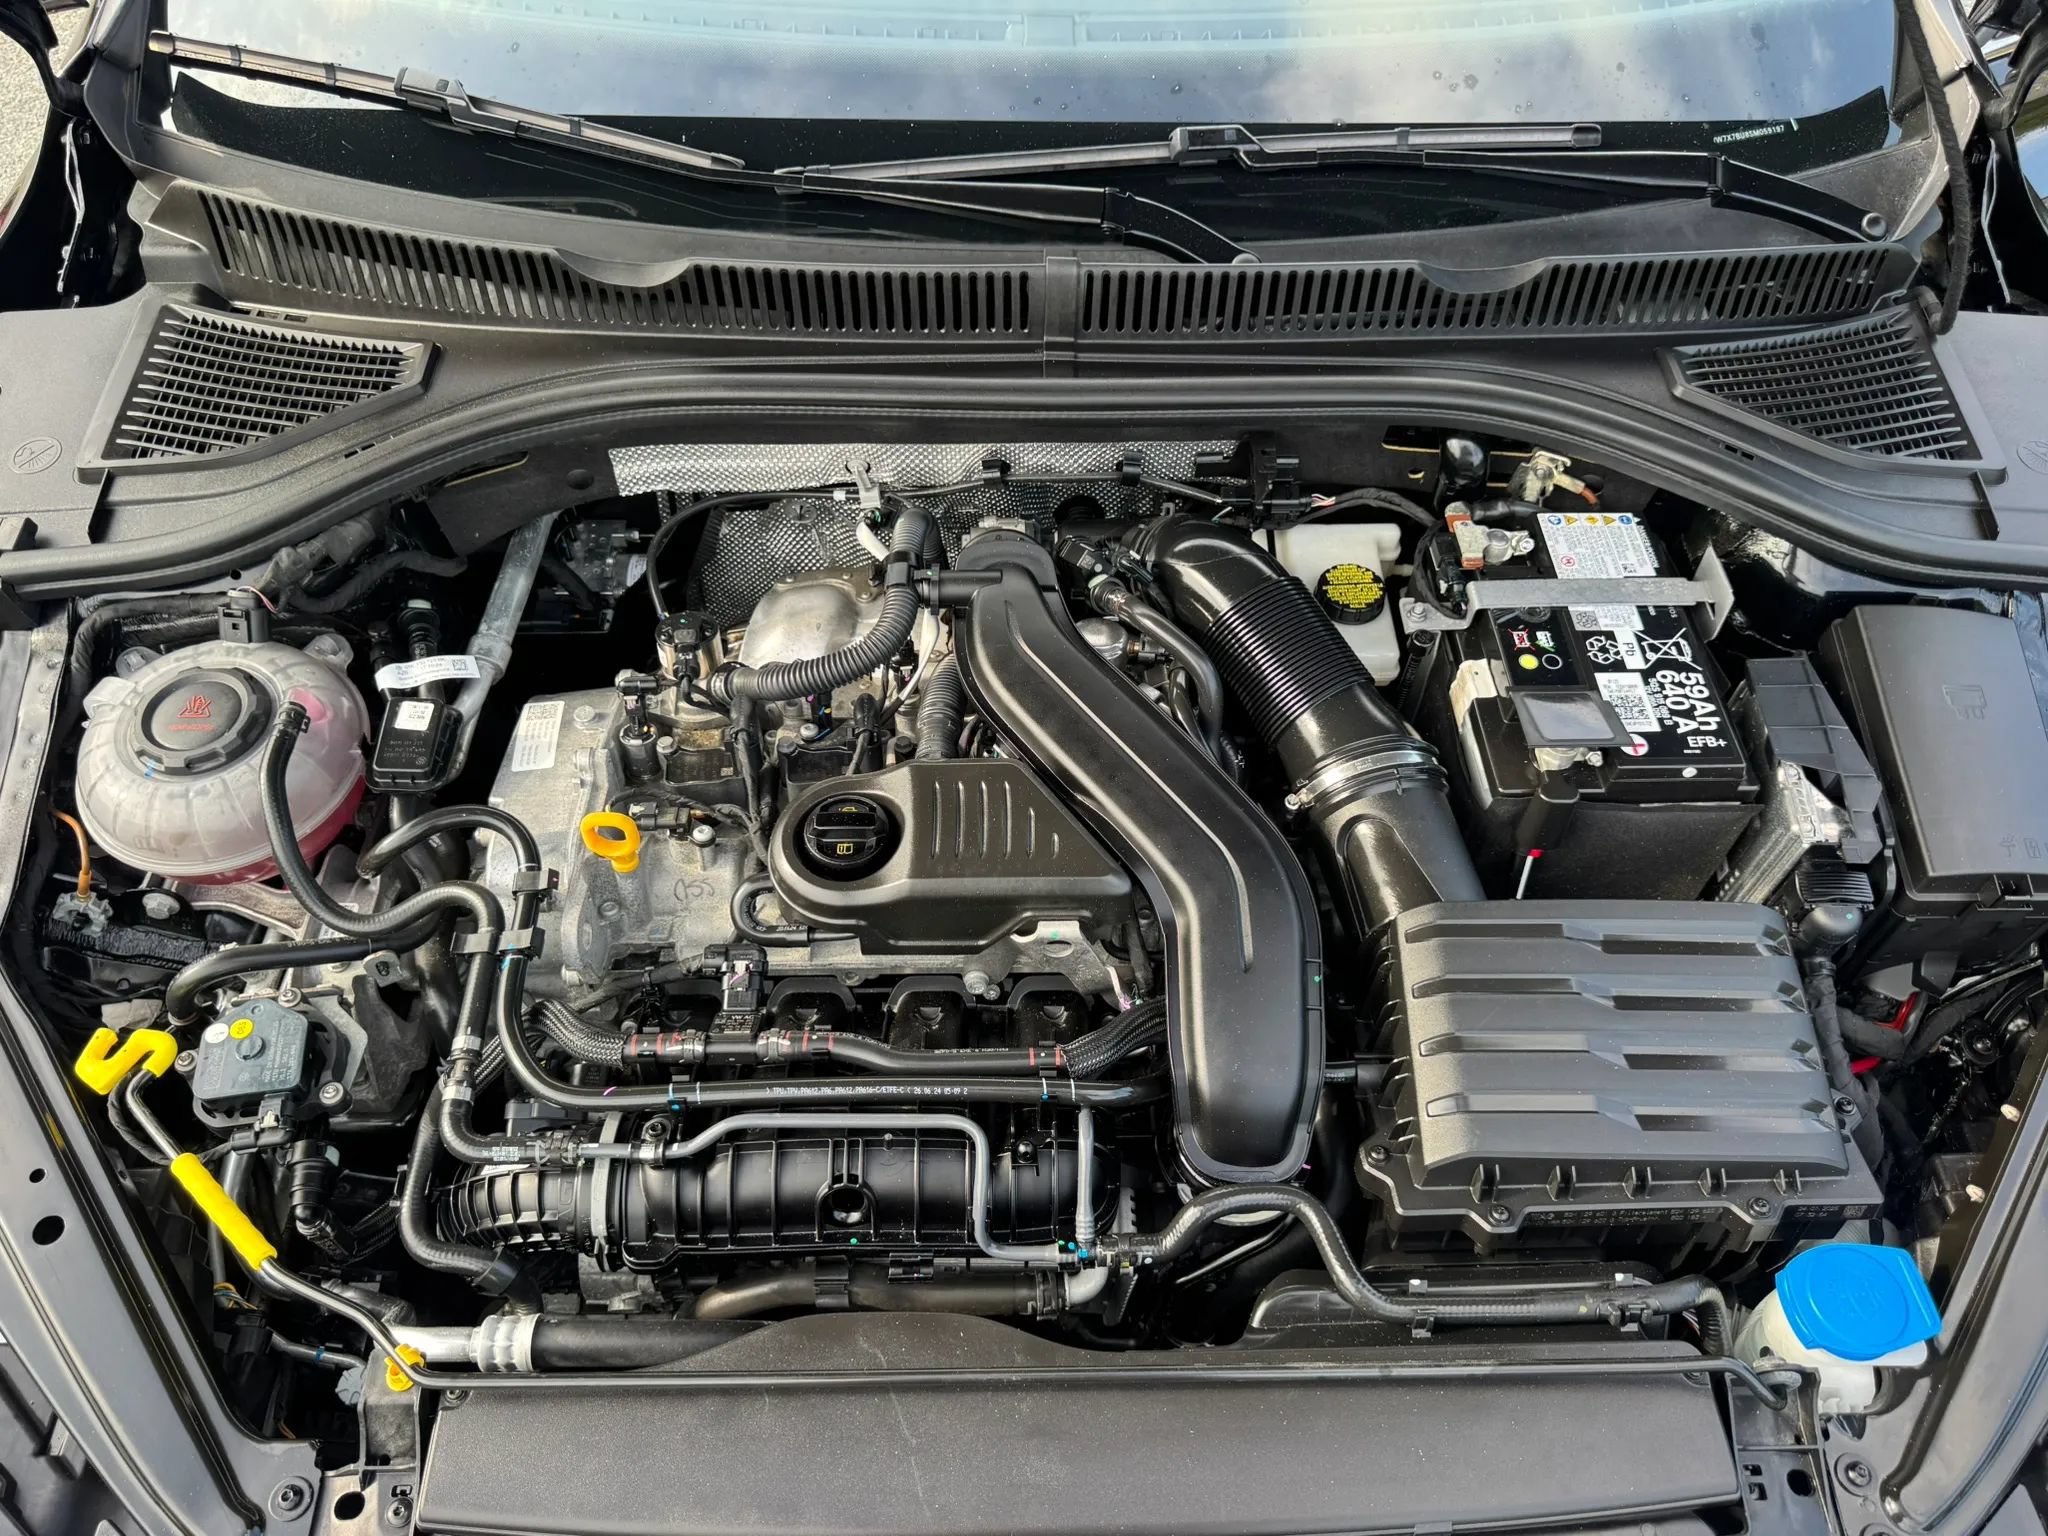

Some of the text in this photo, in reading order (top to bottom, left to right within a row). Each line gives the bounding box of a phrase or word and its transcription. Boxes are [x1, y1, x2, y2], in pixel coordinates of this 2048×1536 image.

[1622, 642, 1636, 656] Pb
[1655, 669, 1700, 734] 640 A
[1679, 671, 1721, 731] 59Ah
[1686, 735, 1728, 748] EFB+
